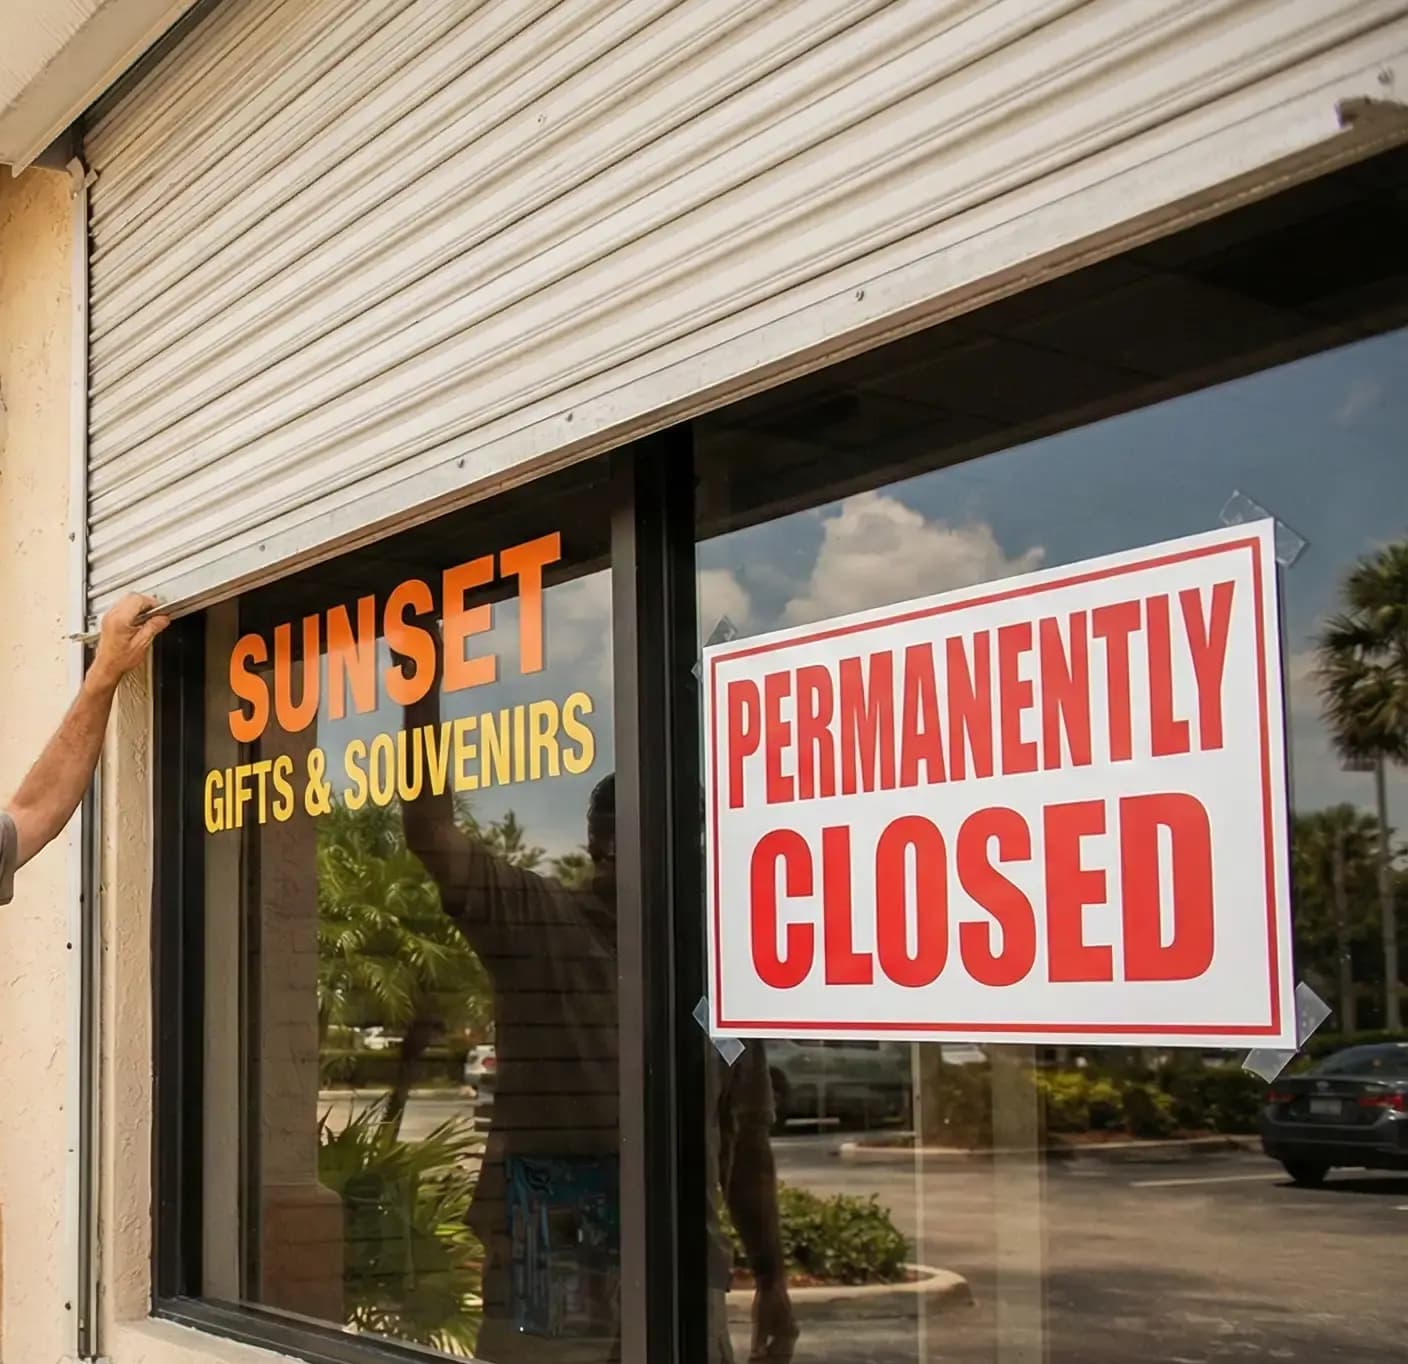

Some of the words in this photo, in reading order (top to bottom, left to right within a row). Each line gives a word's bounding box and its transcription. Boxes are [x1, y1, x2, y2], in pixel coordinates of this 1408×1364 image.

[227, 531, 562, 743] SUNSET
[726, 580, 1236, 810] PERMANENTLY
[204, 755, 294, 834] GIFTS
[304, 747, 332, 817] &
[343, 691, 596, 811] SOUVENIRS
[749, 792, 1216, 989] CLOSED
